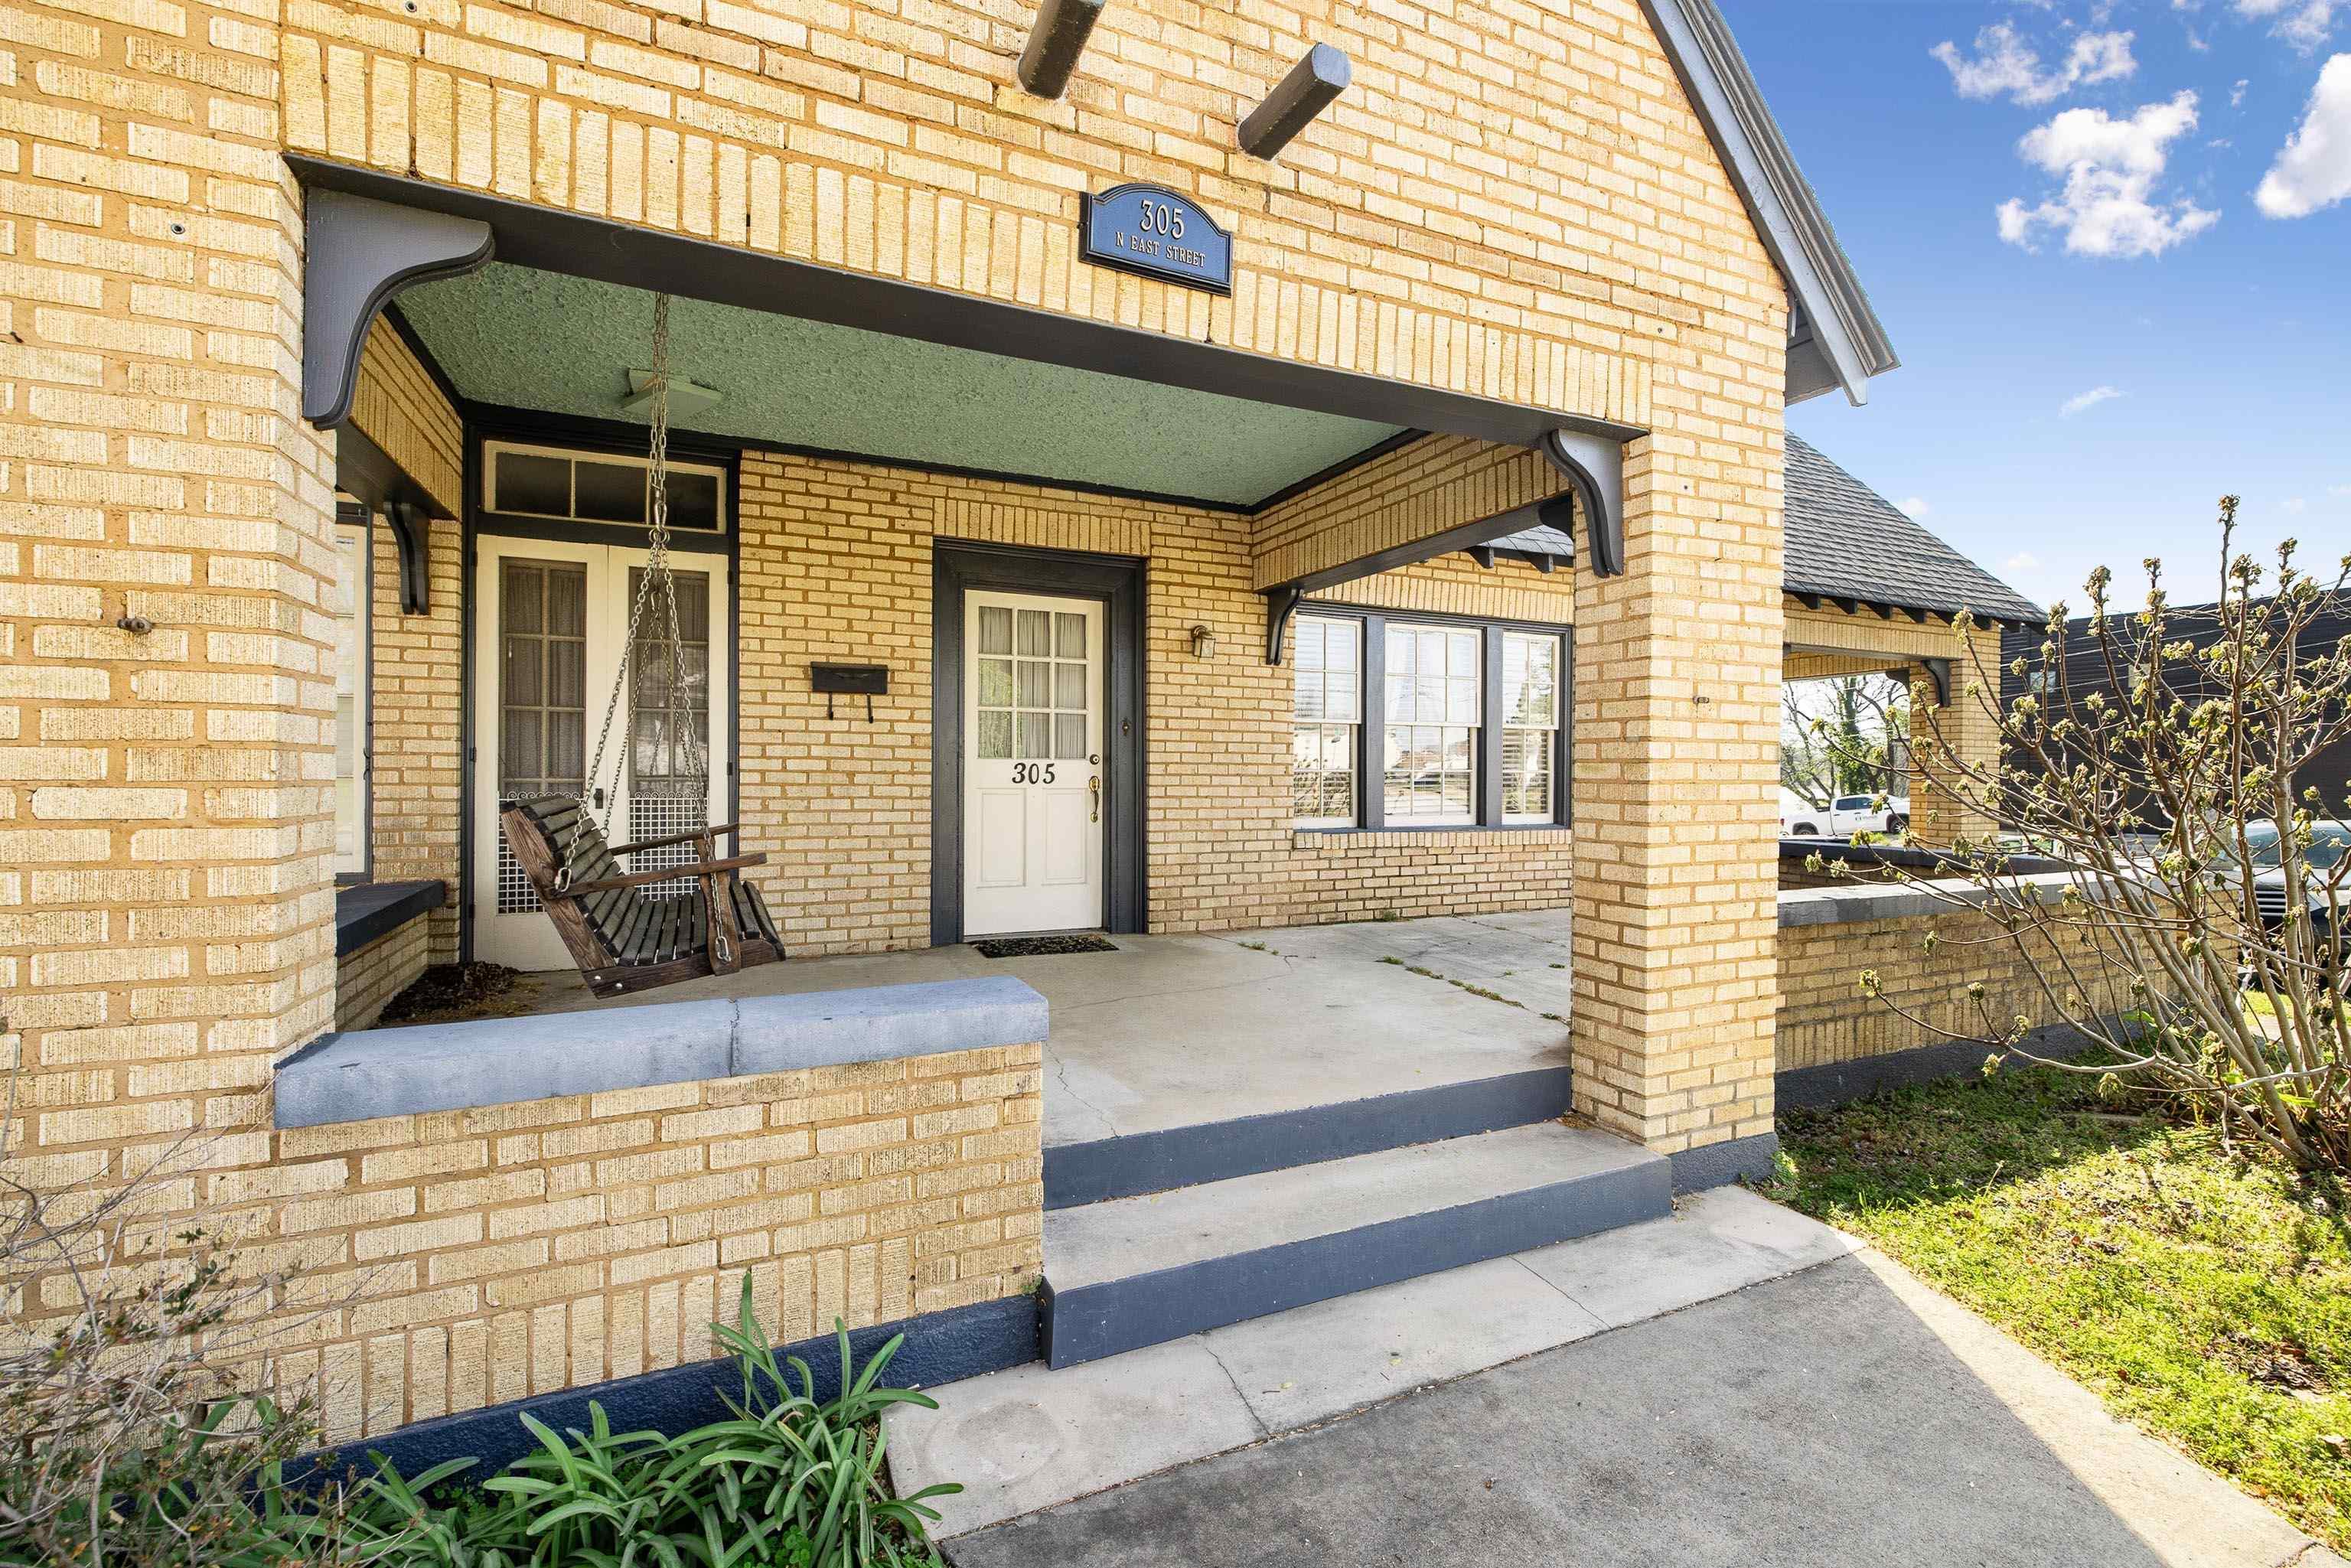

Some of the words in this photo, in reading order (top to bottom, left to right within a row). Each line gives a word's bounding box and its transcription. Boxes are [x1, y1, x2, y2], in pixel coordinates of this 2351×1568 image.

[1140, 200, 1185, 239] 305
[1116, 231, 1124, 246] N
[1131, 236, 1159, 256] EAST
[1166, 244, 1205, 268] STREET
[1012, 762, 1055, 784] 305
